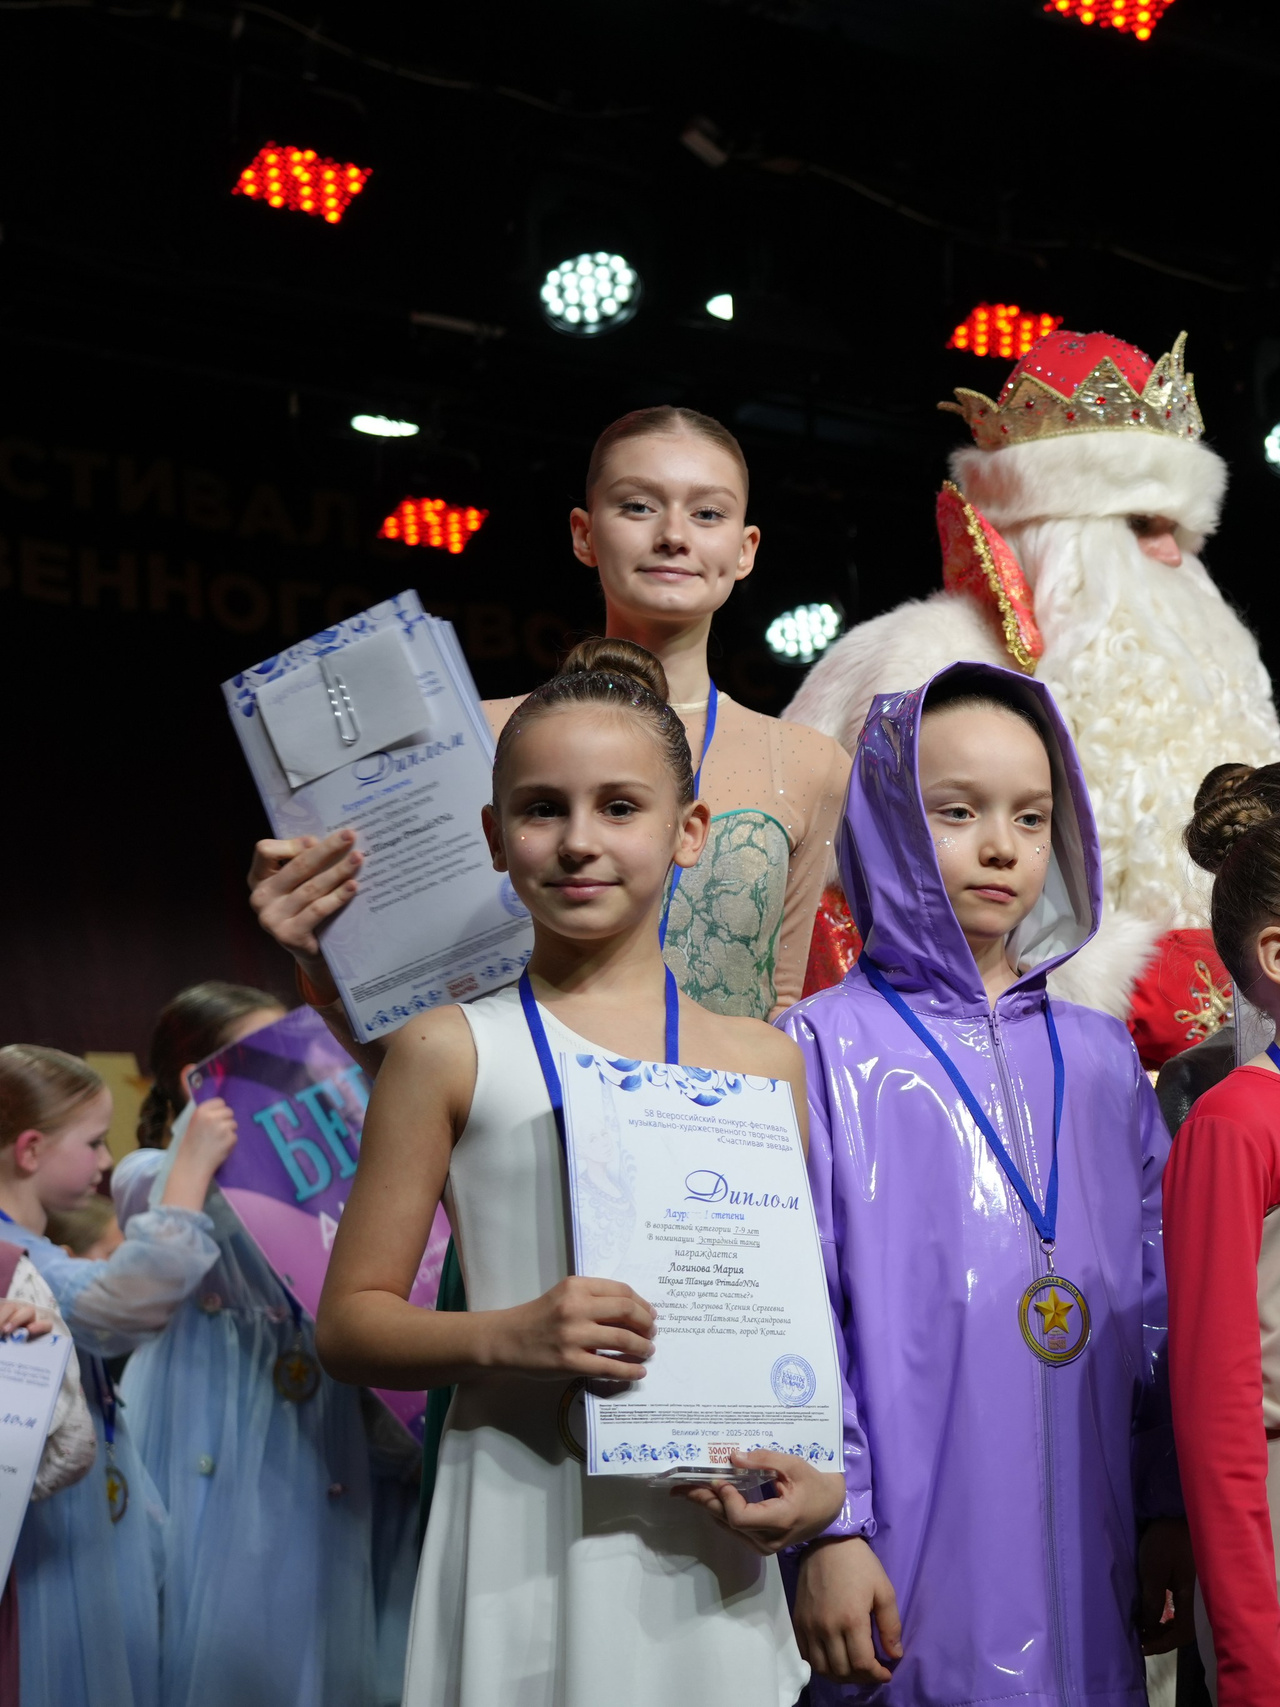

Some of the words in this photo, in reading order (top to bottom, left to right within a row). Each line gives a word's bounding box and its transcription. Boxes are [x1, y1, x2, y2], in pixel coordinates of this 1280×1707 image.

[644, 1109, 655, 1118] 58
[656, 1110, 717, 1124] Всероссийский
[718, 1117, 788, 1134] конкурс-фестиваль
[628, 1118, 747, 1137] музыкально-художественного
[748, 1130, 790, 1143] творчества
[717, 1136, 765, 1149] «Счастливая
[766, 1142, 793, 1152] звезда»
[684, 1169, 800, 1211] Диплом
[711, 1211, 745, 1221] степени
[652, 1222, 694, 1231] возрастной
[694, 1224, 732, 1233] категории
[655, 1235, 695, 1244] номинации
[698, 1235, 739, 1246] Эстрадный
[674, 1248, 738, 1260] награждается
[668, 1262, 711, 1274] Логинова
[712, 1264, 744, 1277] Мария
[658, 1276, 684, 1286] Школа
[684, 1277, 714, 1287] Танцев
[666, 1288, 696, 1299] «Какого
[697, 1290, 718, 1299] цвета
[725, 1303, 751, 1313] Ксения
[752, 1303, 785, 1314] Сергеевна
[703, 1314, 739, 1323] Татьяна
[740, 1315, 792, 1326] Александровна
[657, 1327, 706, 1336] рхангельская
[739, 1328, 759, 1337] город
[760, 1328, 786, 1337] Котлас
[672, 1428, 700, 1436] Великий
[701, 1429, 720, 1437] Устюг
[726, 1429, 761, 1437] 2025-2026
